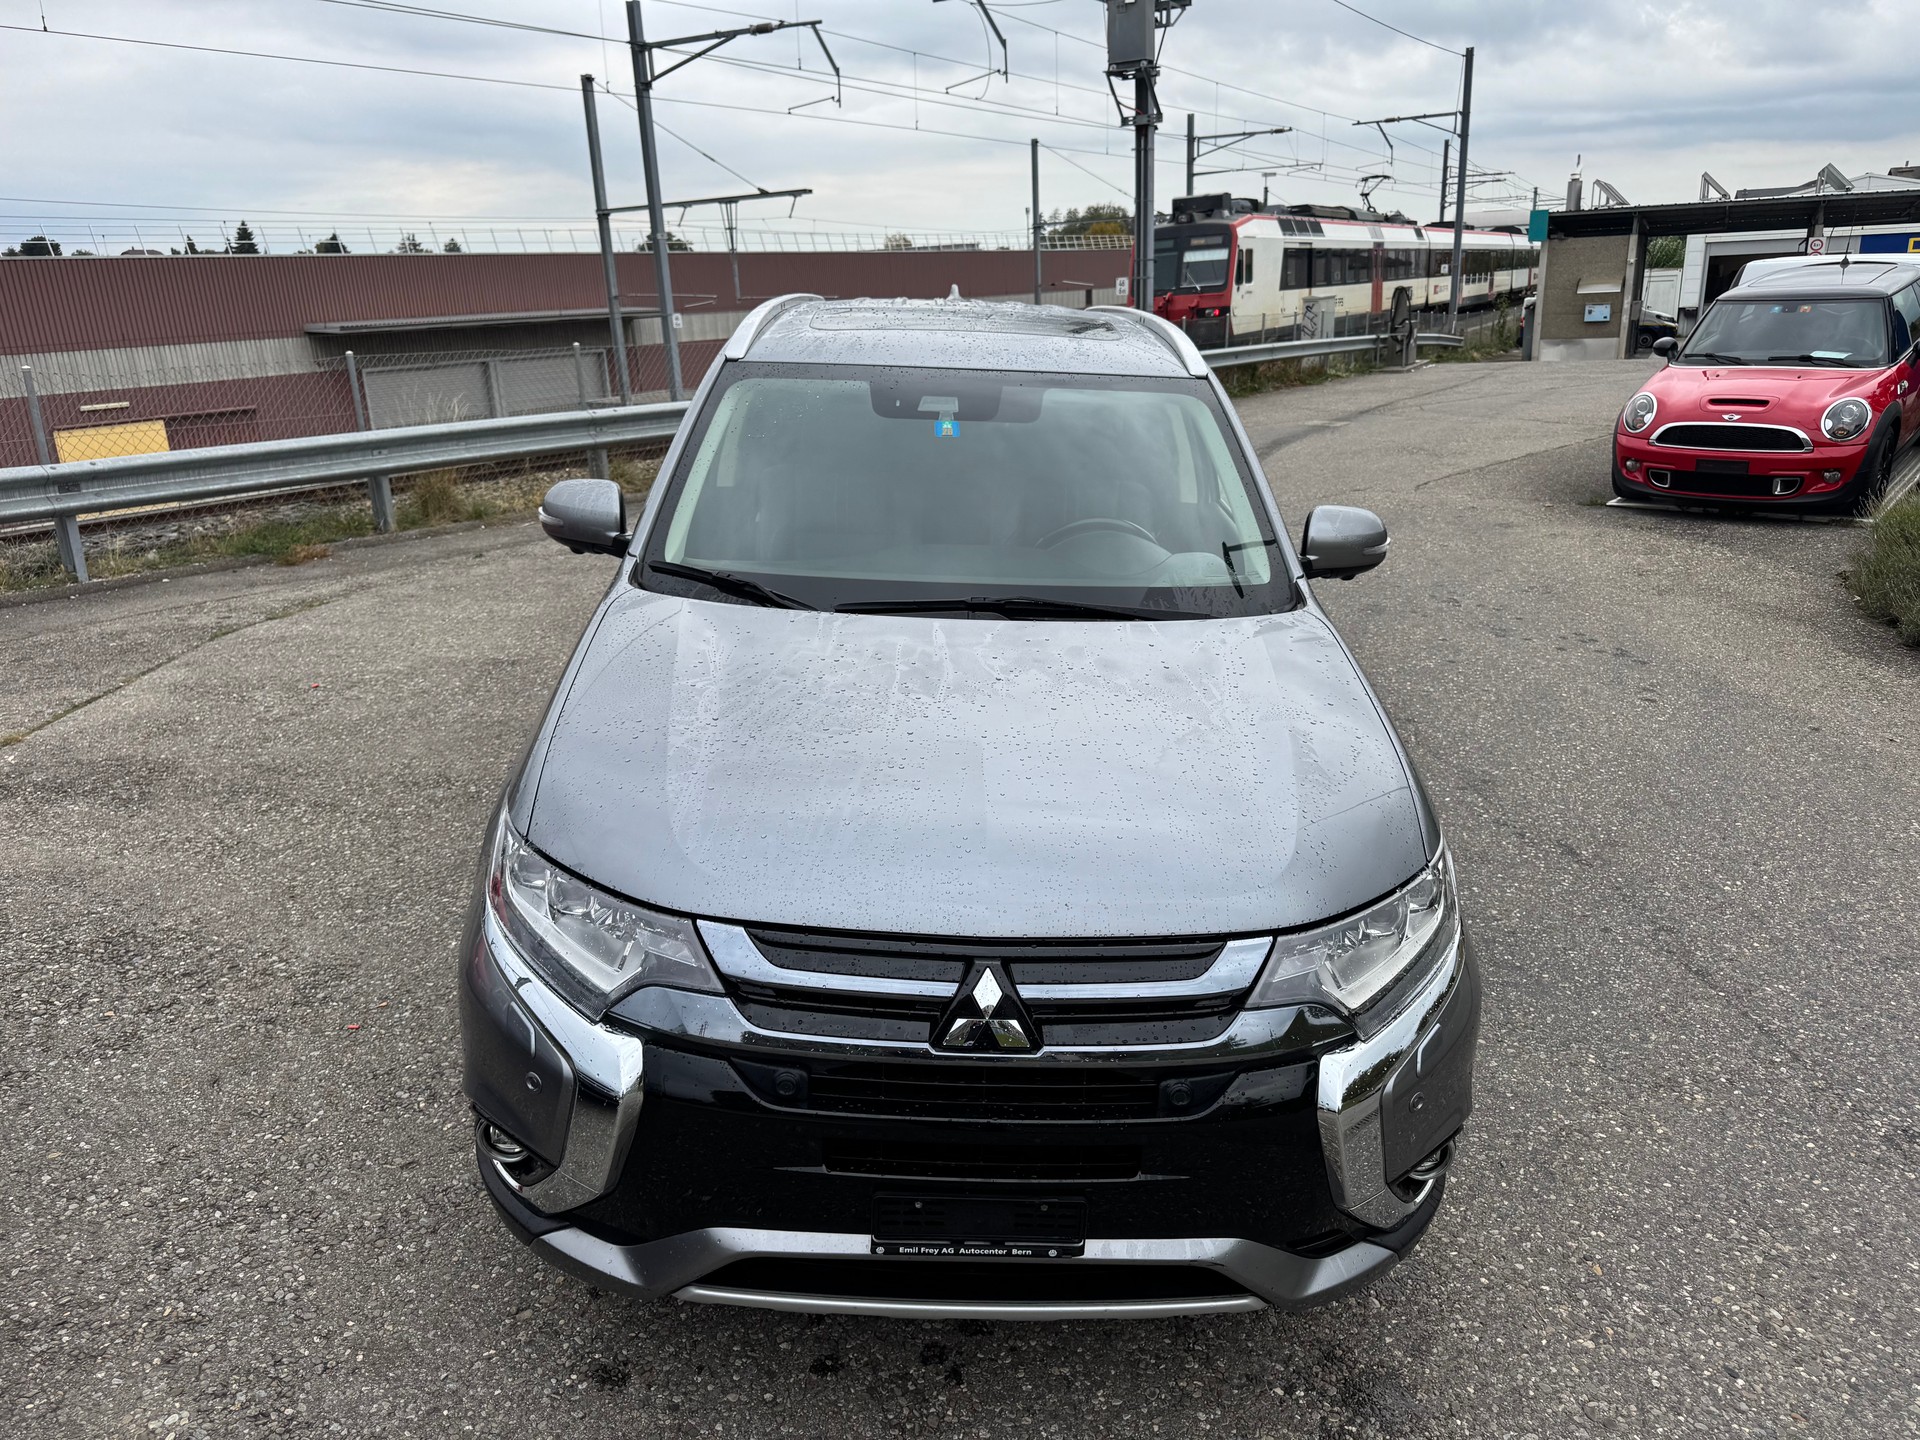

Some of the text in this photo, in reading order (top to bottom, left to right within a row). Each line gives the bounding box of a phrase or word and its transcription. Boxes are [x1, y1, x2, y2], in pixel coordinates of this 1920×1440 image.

[899, 1246, 918, 1254] Emil
[921, 1247, 939, 1255] Frey
[941, 1247, 955, 1255] AG
[959, 1247, 1008, 1255] Autocenter
